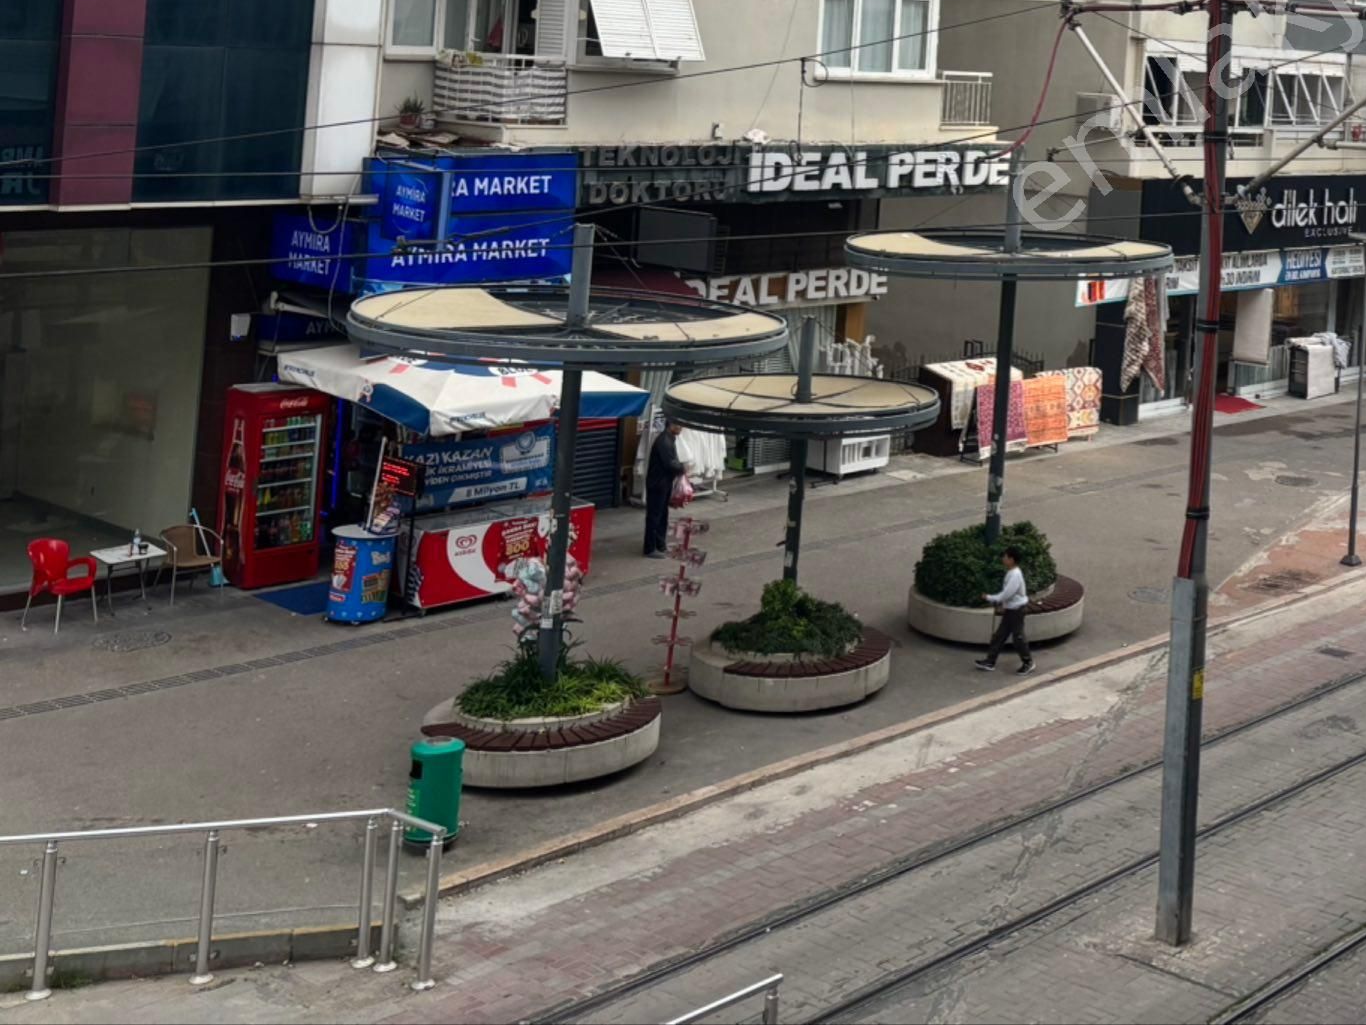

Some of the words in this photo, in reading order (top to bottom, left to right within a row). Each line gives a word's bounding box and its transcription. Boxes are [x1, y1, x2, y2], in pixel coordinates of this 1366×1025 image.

[887, 150, 1012, 189] PERDE
[395, 184, 426, 203] AYMİRA
[474, 175, 553, 196] MARKET
[391, 202, 426, 223] MARKET
[1271, 189, 1316, 228] dilek
[291, 230, 331, 254] AYMİRA
[473, 238, 551, 261] MARKET
[287, 251, 332, 276] MARKET
[787, 268, 889, 300] PERDE
[441, 446, 494, 463] KAZAN
